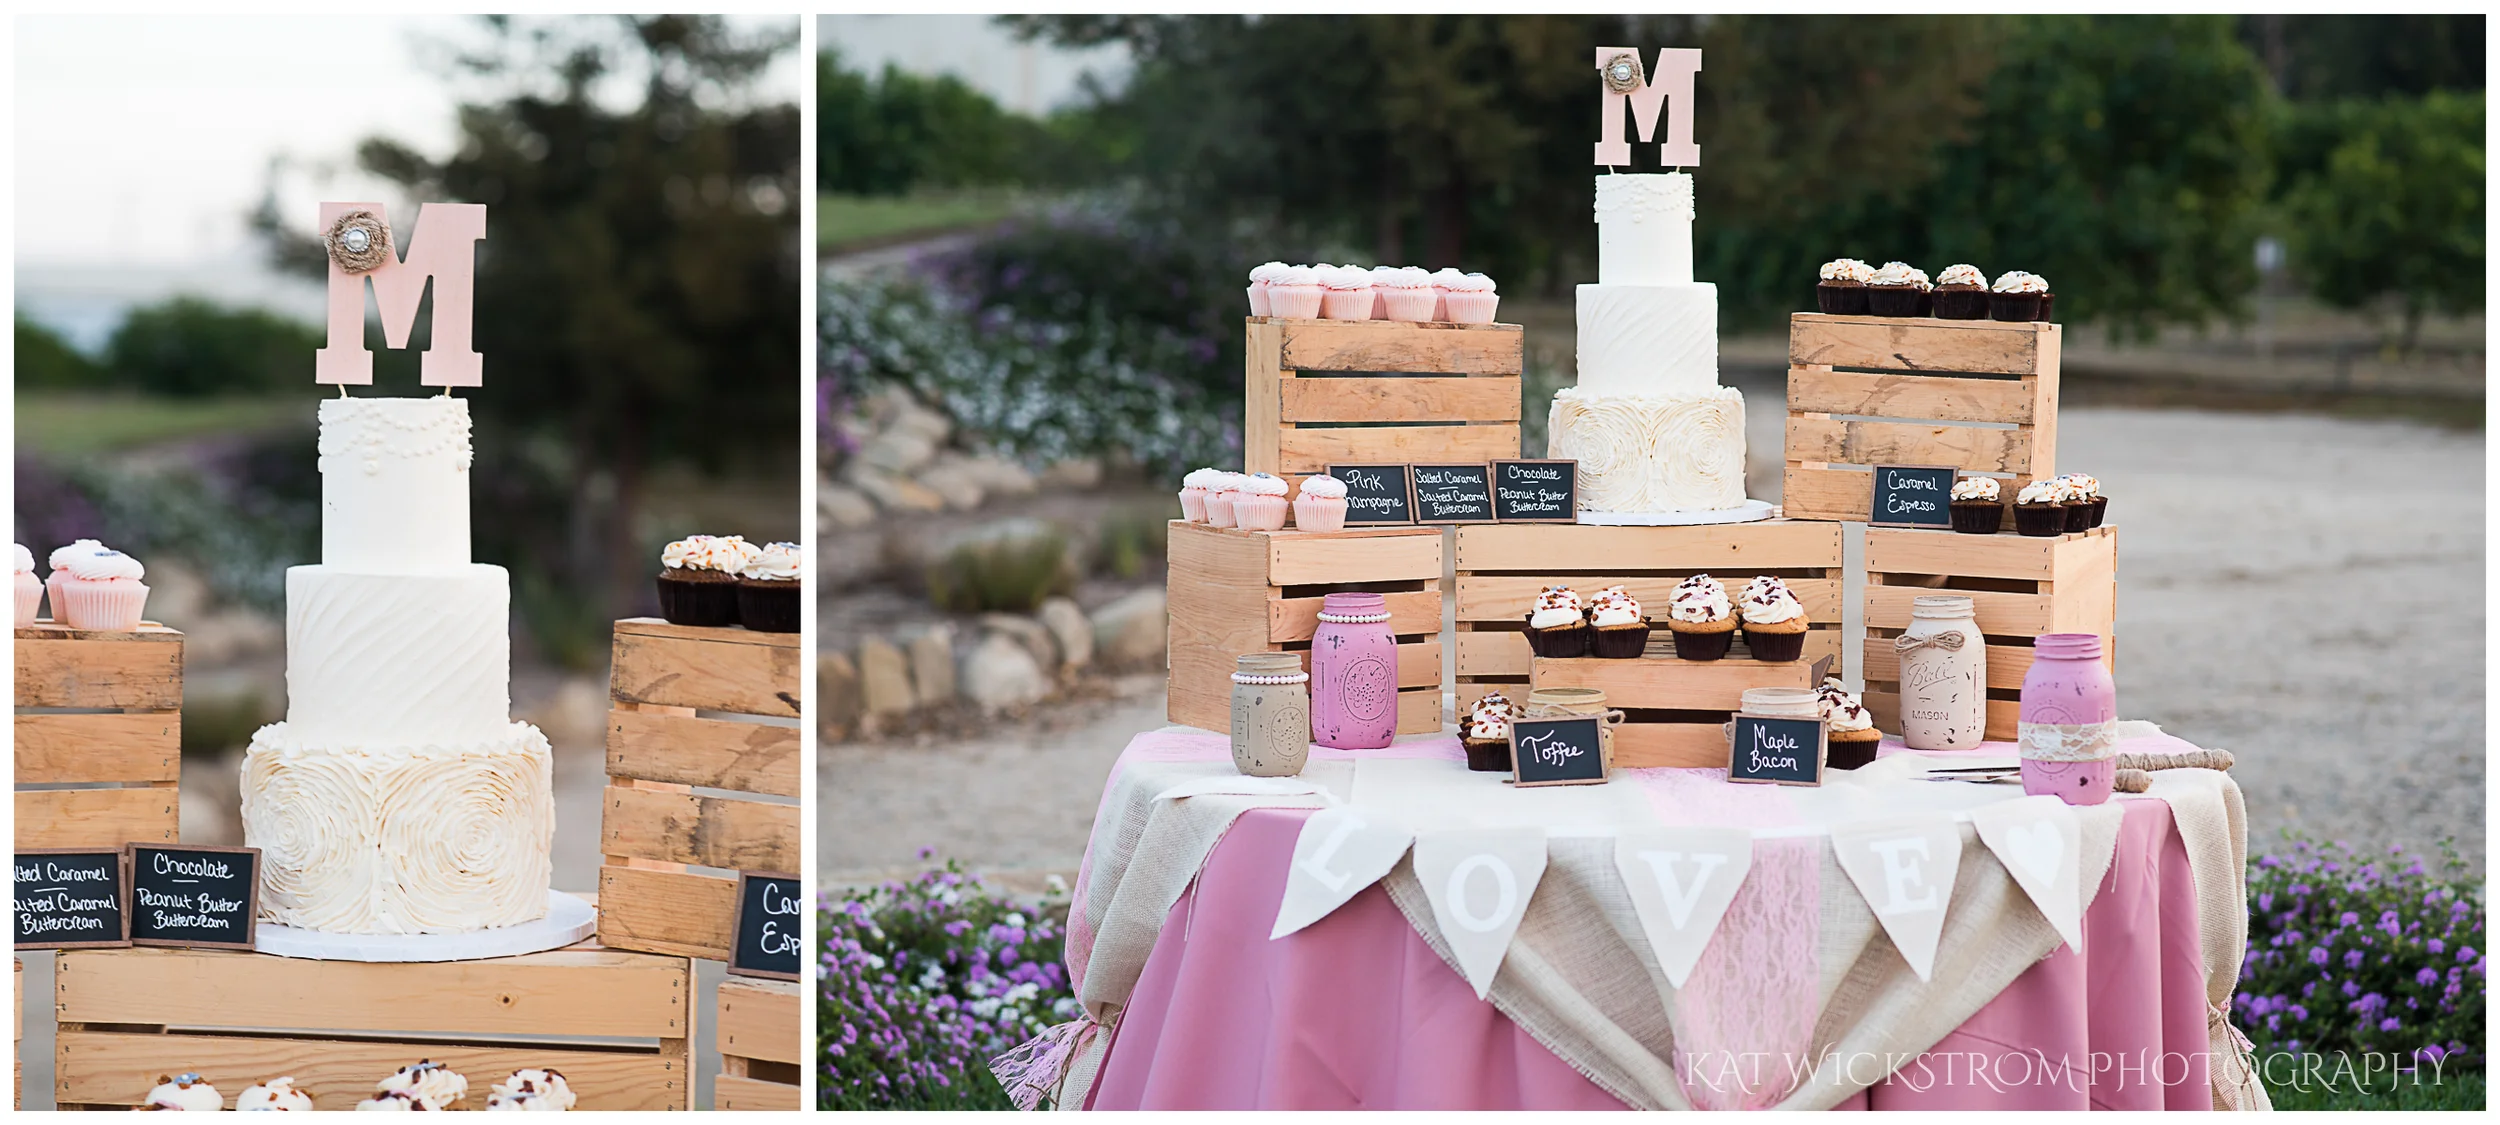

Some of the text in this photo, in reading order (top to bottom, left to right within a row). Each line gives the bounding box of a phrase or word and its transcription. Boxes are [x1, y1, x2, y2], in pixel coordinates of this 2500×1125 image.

[1594, 46, 1702, 167] M
[316, 202, 487, 387] M
[1345, 469, 1385, 491] Pink
[1415, 468, 1482, 484] Salted Caramel
[1508, 465, 1561, 480] Chocolate
[1887, 470, 1938, 491] Caramel
[1418, 488, 1489, 502] Salted Caramel
[1498, 487, 1568, 502] Peanut Butter
[1887, 493, 1936, 513] Espresso
[1345, 496, 1404, 514] hampagne
[1432, 502, 1481, 516] Buttercream
[1510, 501, 1560, 514] Buttercream
[1912, 710, 1949, 720] MASON
[1521, 729, 1584, 767] Toffee
[1753, 723, 1799, 753] Maple
[1747, 749, 1798, 773] Bacon
[47, 862, 110, 882] Caramel
[153, 853, 235, 880] Chocolate
[57, 892, 118, 912] Caramel
[136, 887, 243, 914] Peanut Butter
[20, 913, 104, 935] Buttercream
[152, 910, 230, 930] Buttercream
